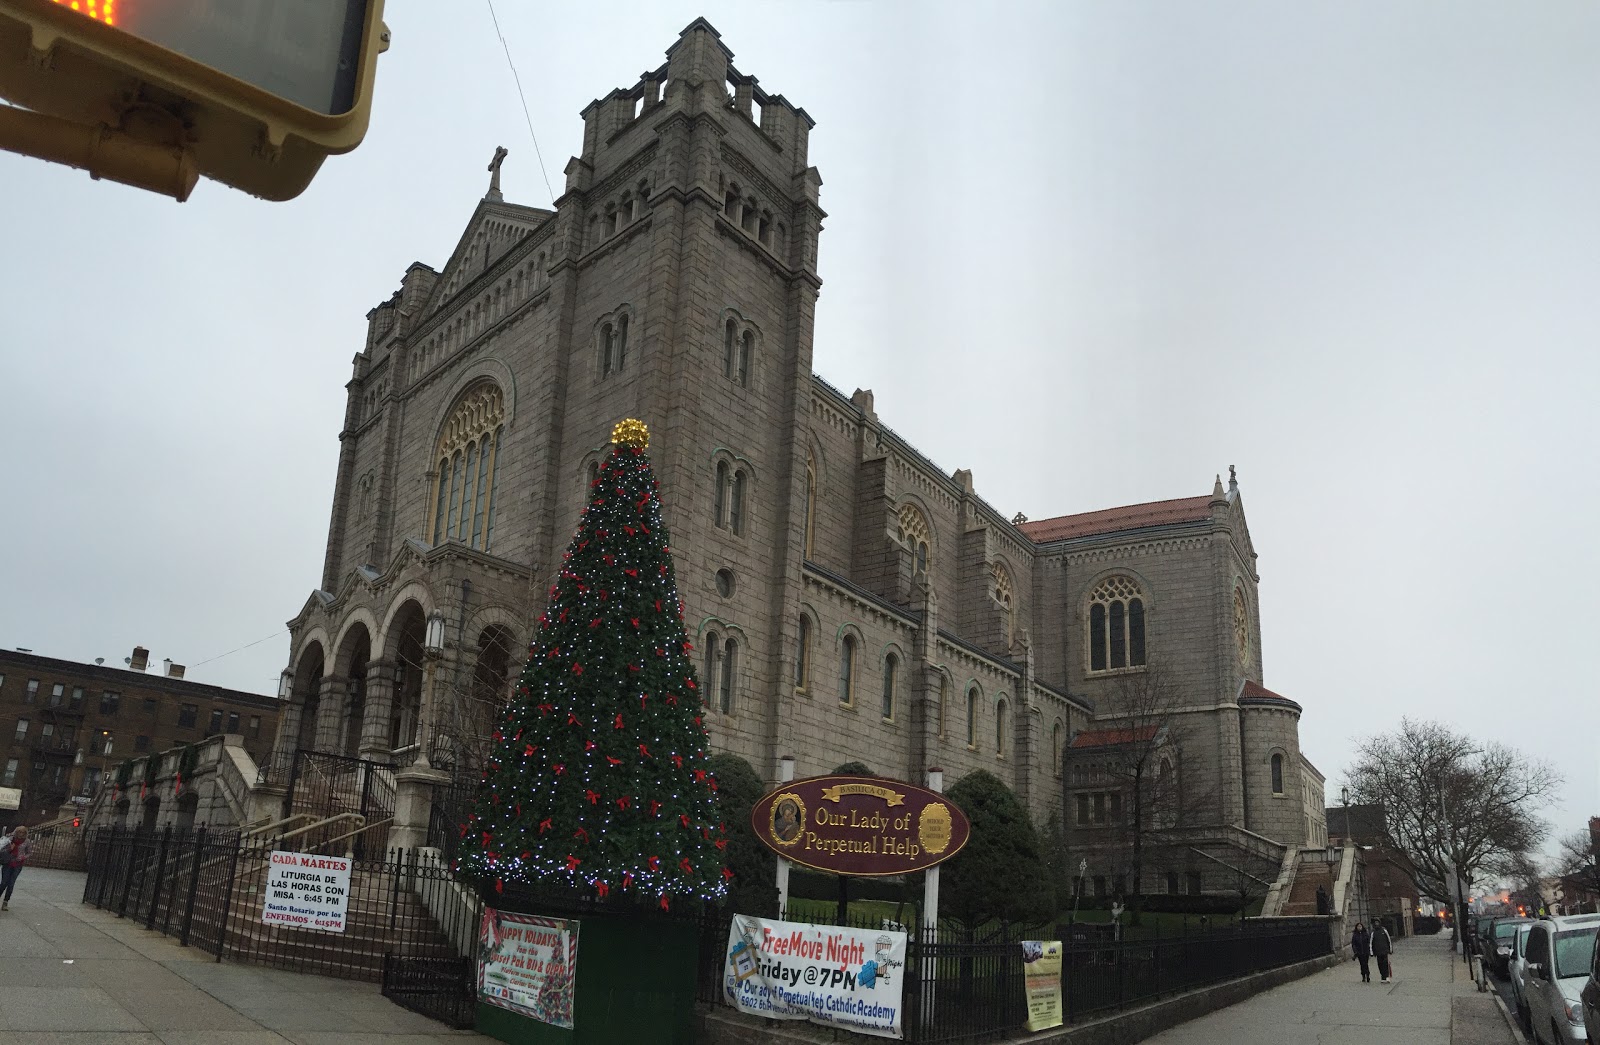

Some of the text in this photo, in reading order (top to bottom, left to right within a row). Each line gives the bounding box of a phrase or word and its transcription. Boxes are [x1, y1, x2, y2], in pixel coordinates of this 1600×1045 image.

[840, 785, 887, 796] BASILICA OF
[815, 807, 912, 833] Our Lady of
[804, 832, 920, 861] Perpetual Help
[272, 854, 347, 871] CADA MARTES
[281, 871, 337, 884] LITURGIA DE
[271, 880, 345, 896] LAS HORAS CON
[273, 890, 294, 900] MISA
[304, 894, 322, 903] 6:45
[325, 896, 339, 905] PM
[267, 903, 287, 912] Santo
[289, 906, 315, 915] Rosario
[316, 909, 329, 917] por
[265, 912, 309, 923] ENFERMOS
[315, 919, 342, 928] 6:15PM
[825, 933, 865, 973] Night
[741, 995, 757, 1009] 5902
[744, 979, 758, 996] Our
[857, 999, 896, 1025] Academy
